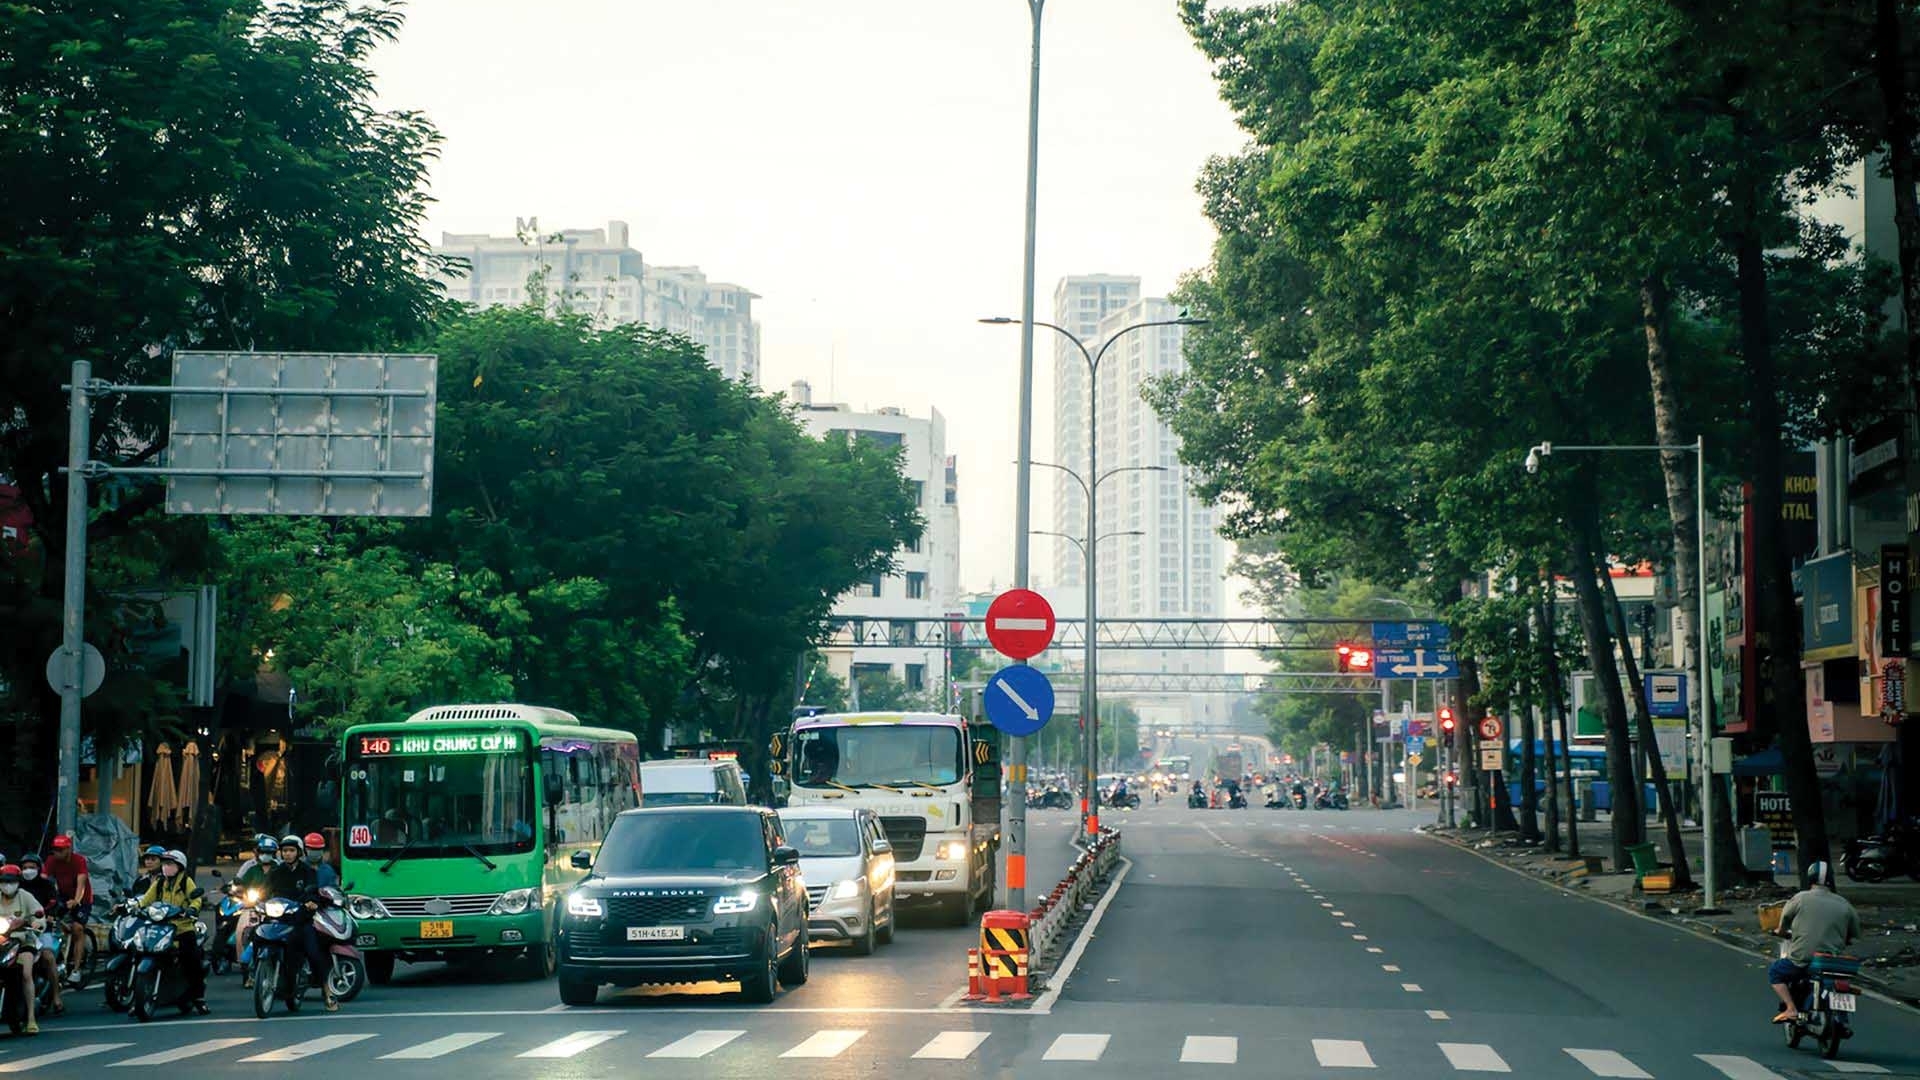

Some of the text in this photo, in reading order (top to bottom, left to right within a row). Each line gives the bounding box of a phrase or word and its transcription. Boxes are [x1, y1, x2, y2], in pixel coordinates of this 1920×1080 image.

[1888, 561, 1902, 652] HOTEL
[361, 739, 390, 754] 140
[403, 736, 429, 752] KHU
[1760, 798, 1792, 811] HOTE
[352, 828, 368, 844] 140
